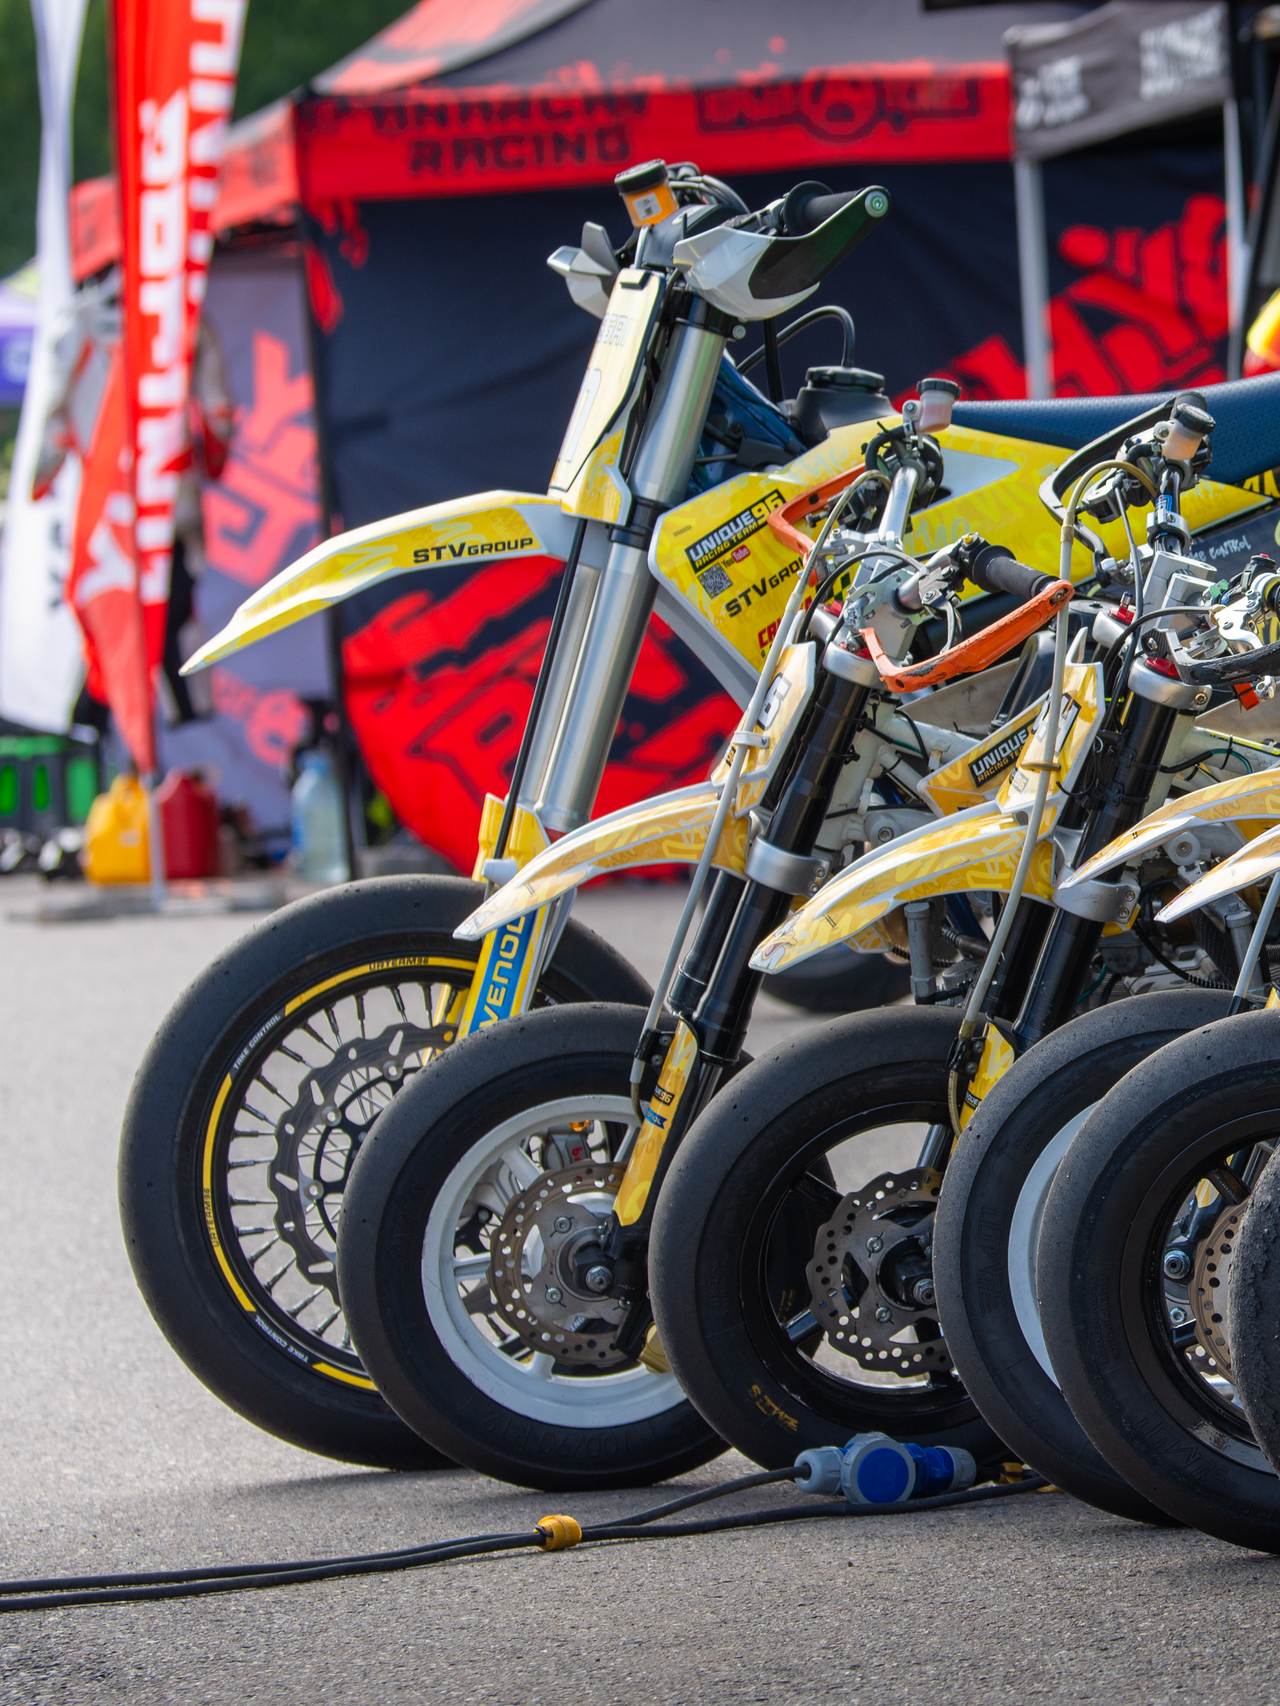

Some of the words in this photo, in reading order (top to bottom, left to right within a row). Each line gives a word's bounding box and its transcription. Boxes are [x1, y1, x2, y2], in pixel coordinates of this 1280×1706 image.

[694, 539, 731, 568] RACING
[731, 521, 760, 545] TEAM
[972, 720, 1032, 778] UNIQUE
[977, 757, 1009, 783] RACING
[478, 916, 526, 1029] VENOL
